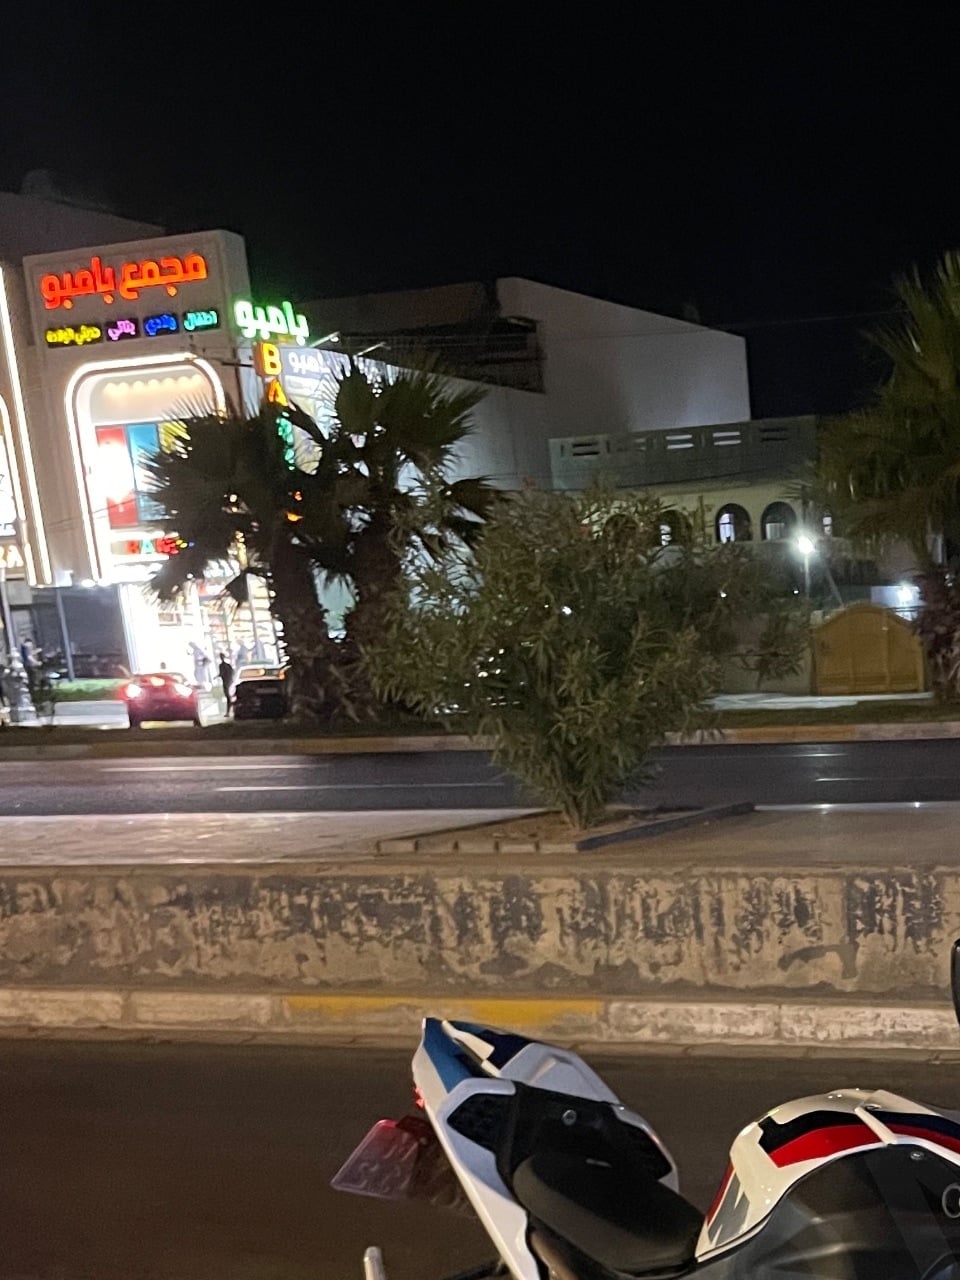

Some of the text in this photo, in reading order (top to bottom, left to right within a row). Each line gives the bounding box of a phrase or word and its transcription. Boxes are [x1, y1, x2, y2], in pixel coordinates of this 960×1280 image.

[40, 252, 208, 310] مجمع بامبو
[234, 300, 310, 346] بامبو
